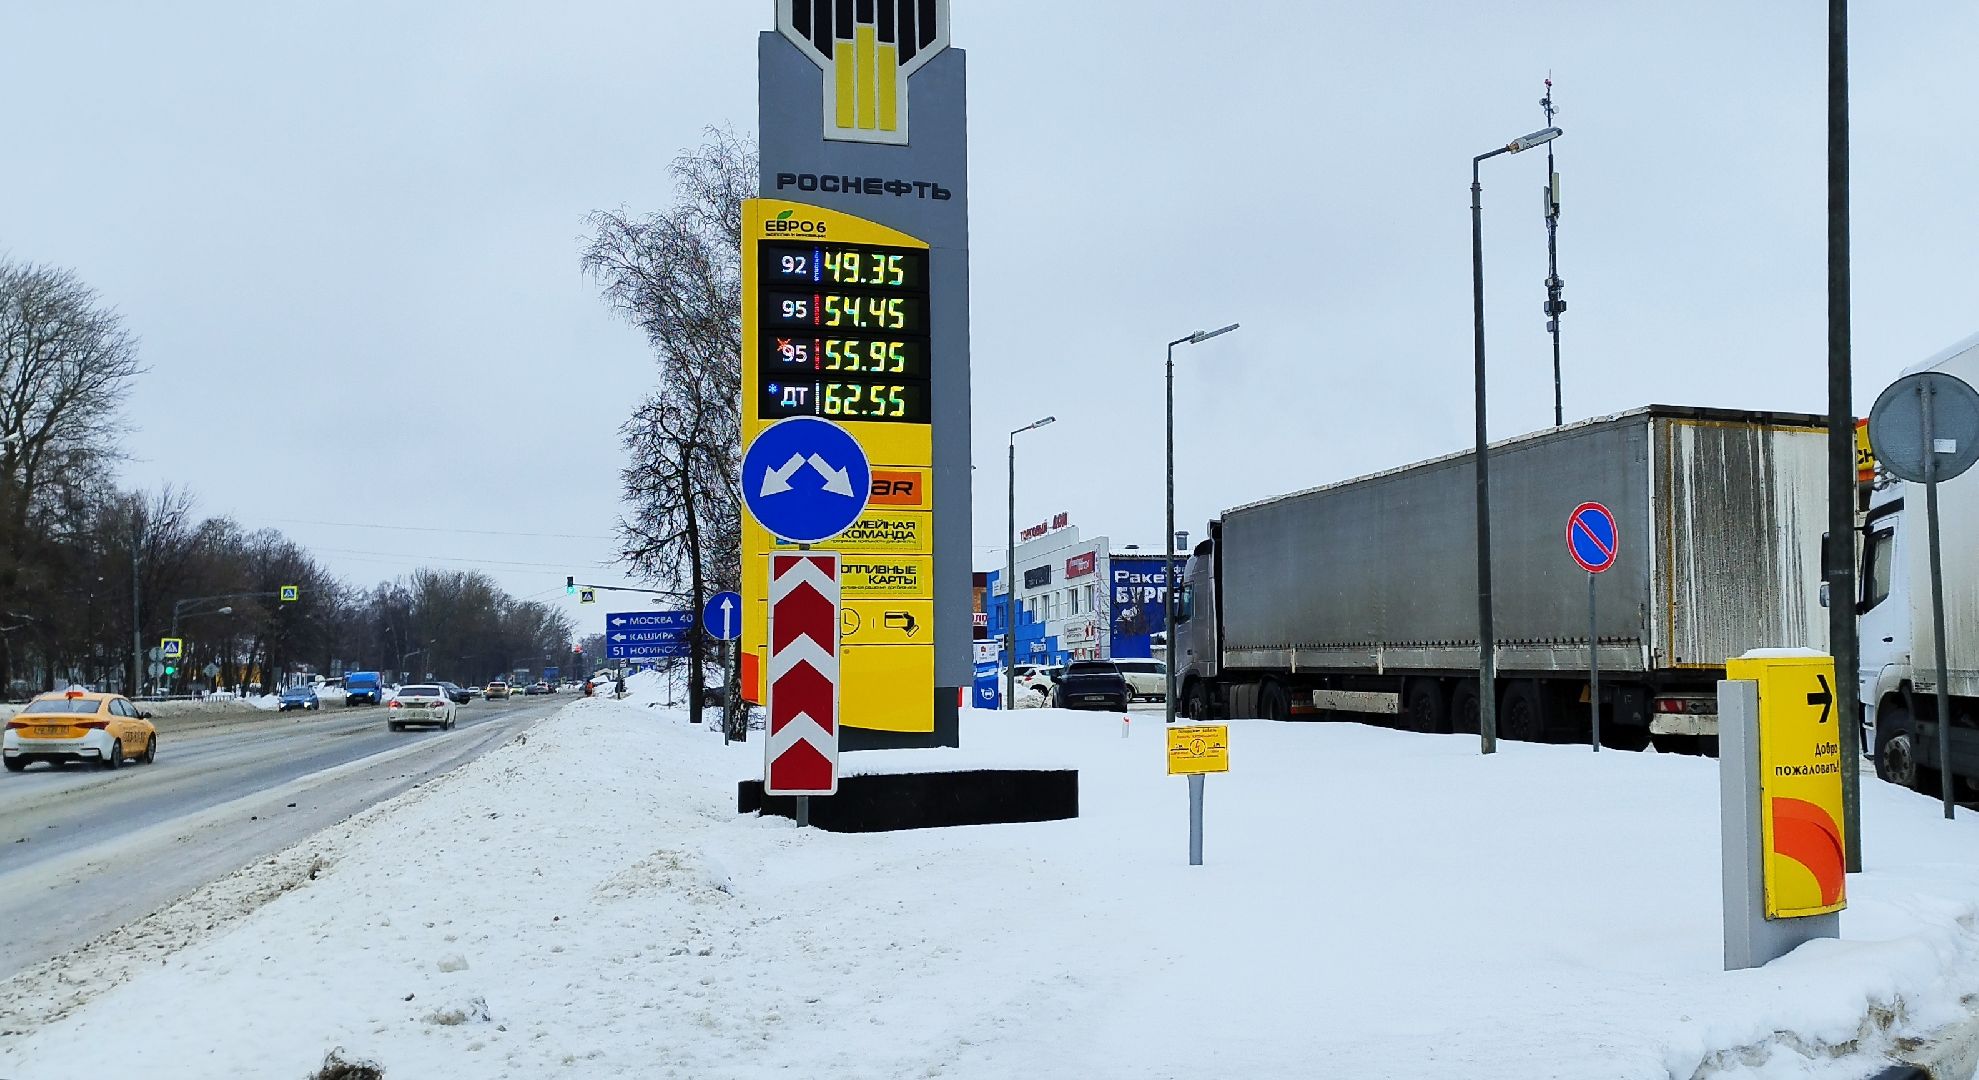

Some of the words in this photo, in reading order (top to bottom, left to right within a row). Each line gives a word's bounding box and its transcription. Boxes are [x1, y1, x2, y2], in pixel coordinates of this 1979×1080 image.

[777, 172, 951, 200] РОСНЕФТЬ
[781, 255, 807, 275] 92
[824, 251, 904, 286] 49.35
[781, 300, 807, 319] 95
[824, 295, 904, 329] 54.45
[781, 345, 808, 363] 95
[824, 340, 905, 373] 55.95
[780, 386, 808, 407] ДТ
[824, 383, 905, 416] 62.55
[850, 520, 916, 530] МЕЙНАЯ
[842, 530, 915, 540] КОМАНДА
[841, 564, 917, 575] ОПЛИВНЫЕ
[868, 575, 917, 585] КАРТЫ
[629, 616, 674, 625] МОСКВА
[629, 632, 676, 641] КАШИРА
[629, 645, 678, 655] НОГИНСК
[1815, 742, 1838, 757] Добро
[1776, 760, 1839, 776] пожаловать!
